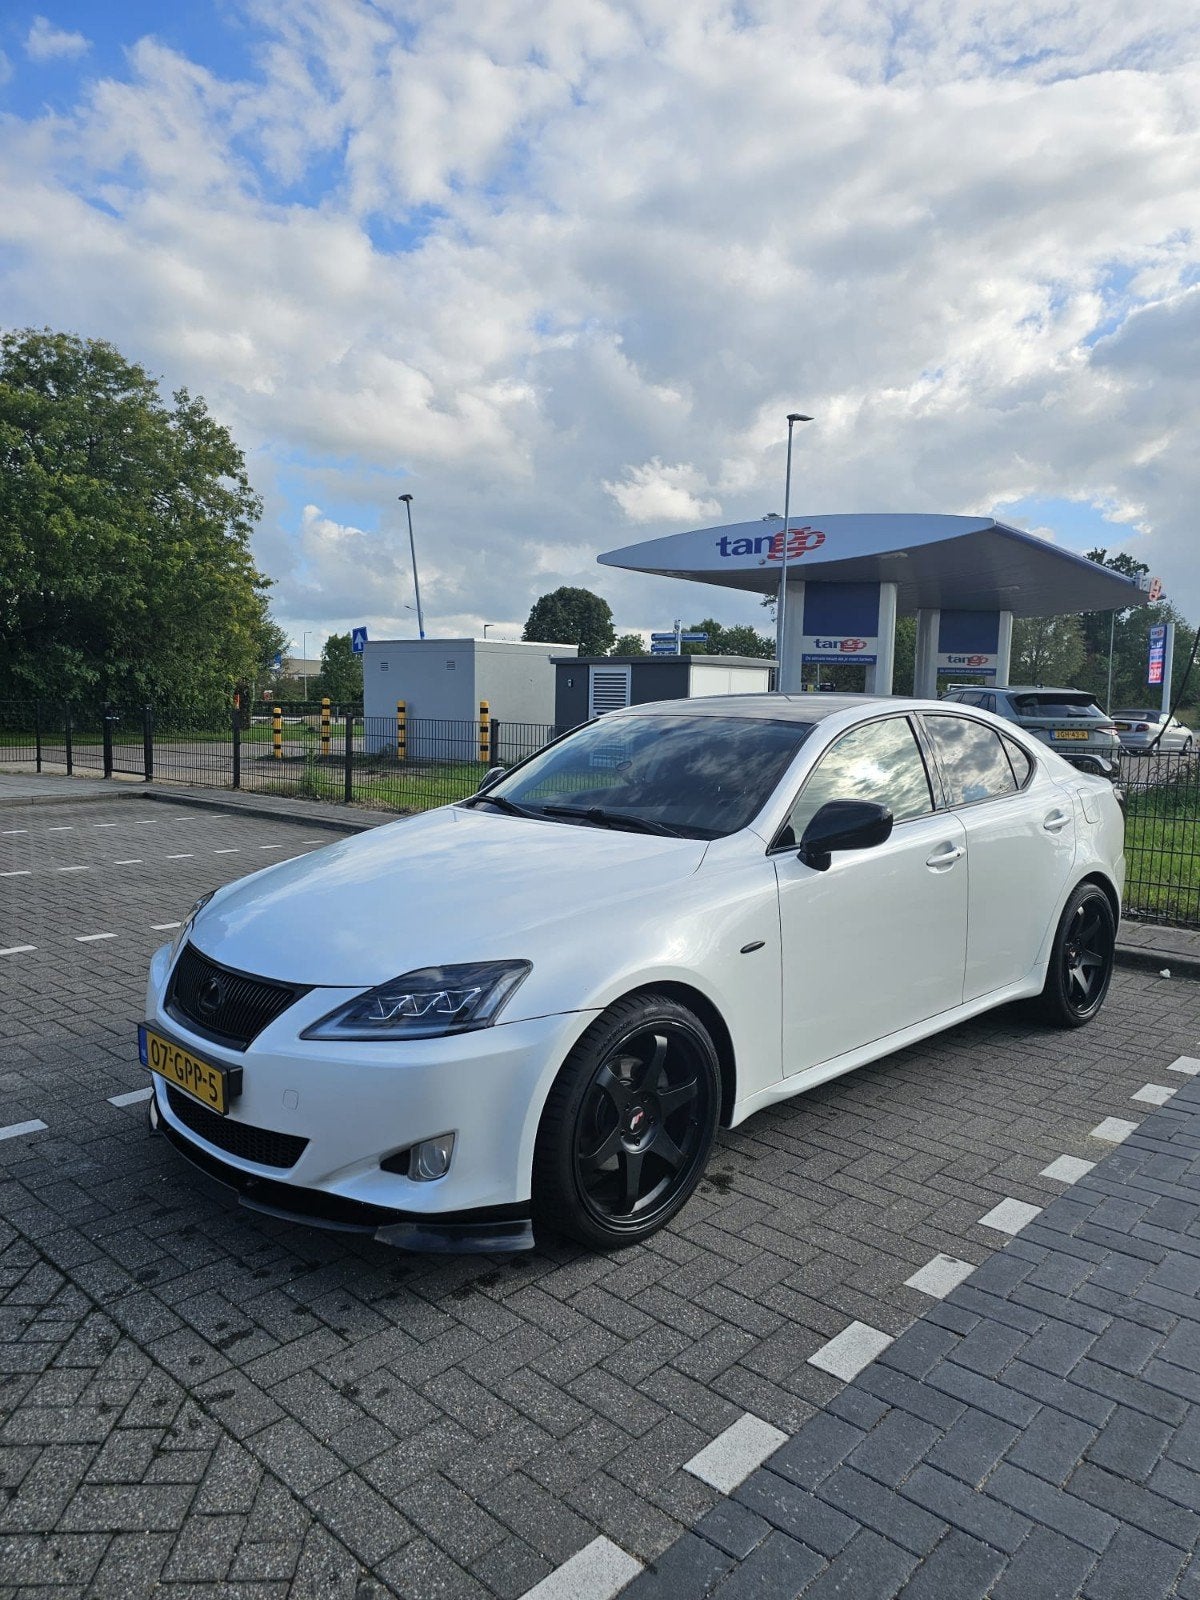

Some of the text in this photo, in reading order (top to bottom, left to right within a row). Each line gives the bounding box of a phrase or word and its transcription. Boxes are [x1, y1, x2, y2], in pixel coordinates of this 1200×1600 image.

[716, 526, 826, 561] tango
[813, 638, 867, 653] tango
[151, 1038, 218, 1103] 07-GPP-5
